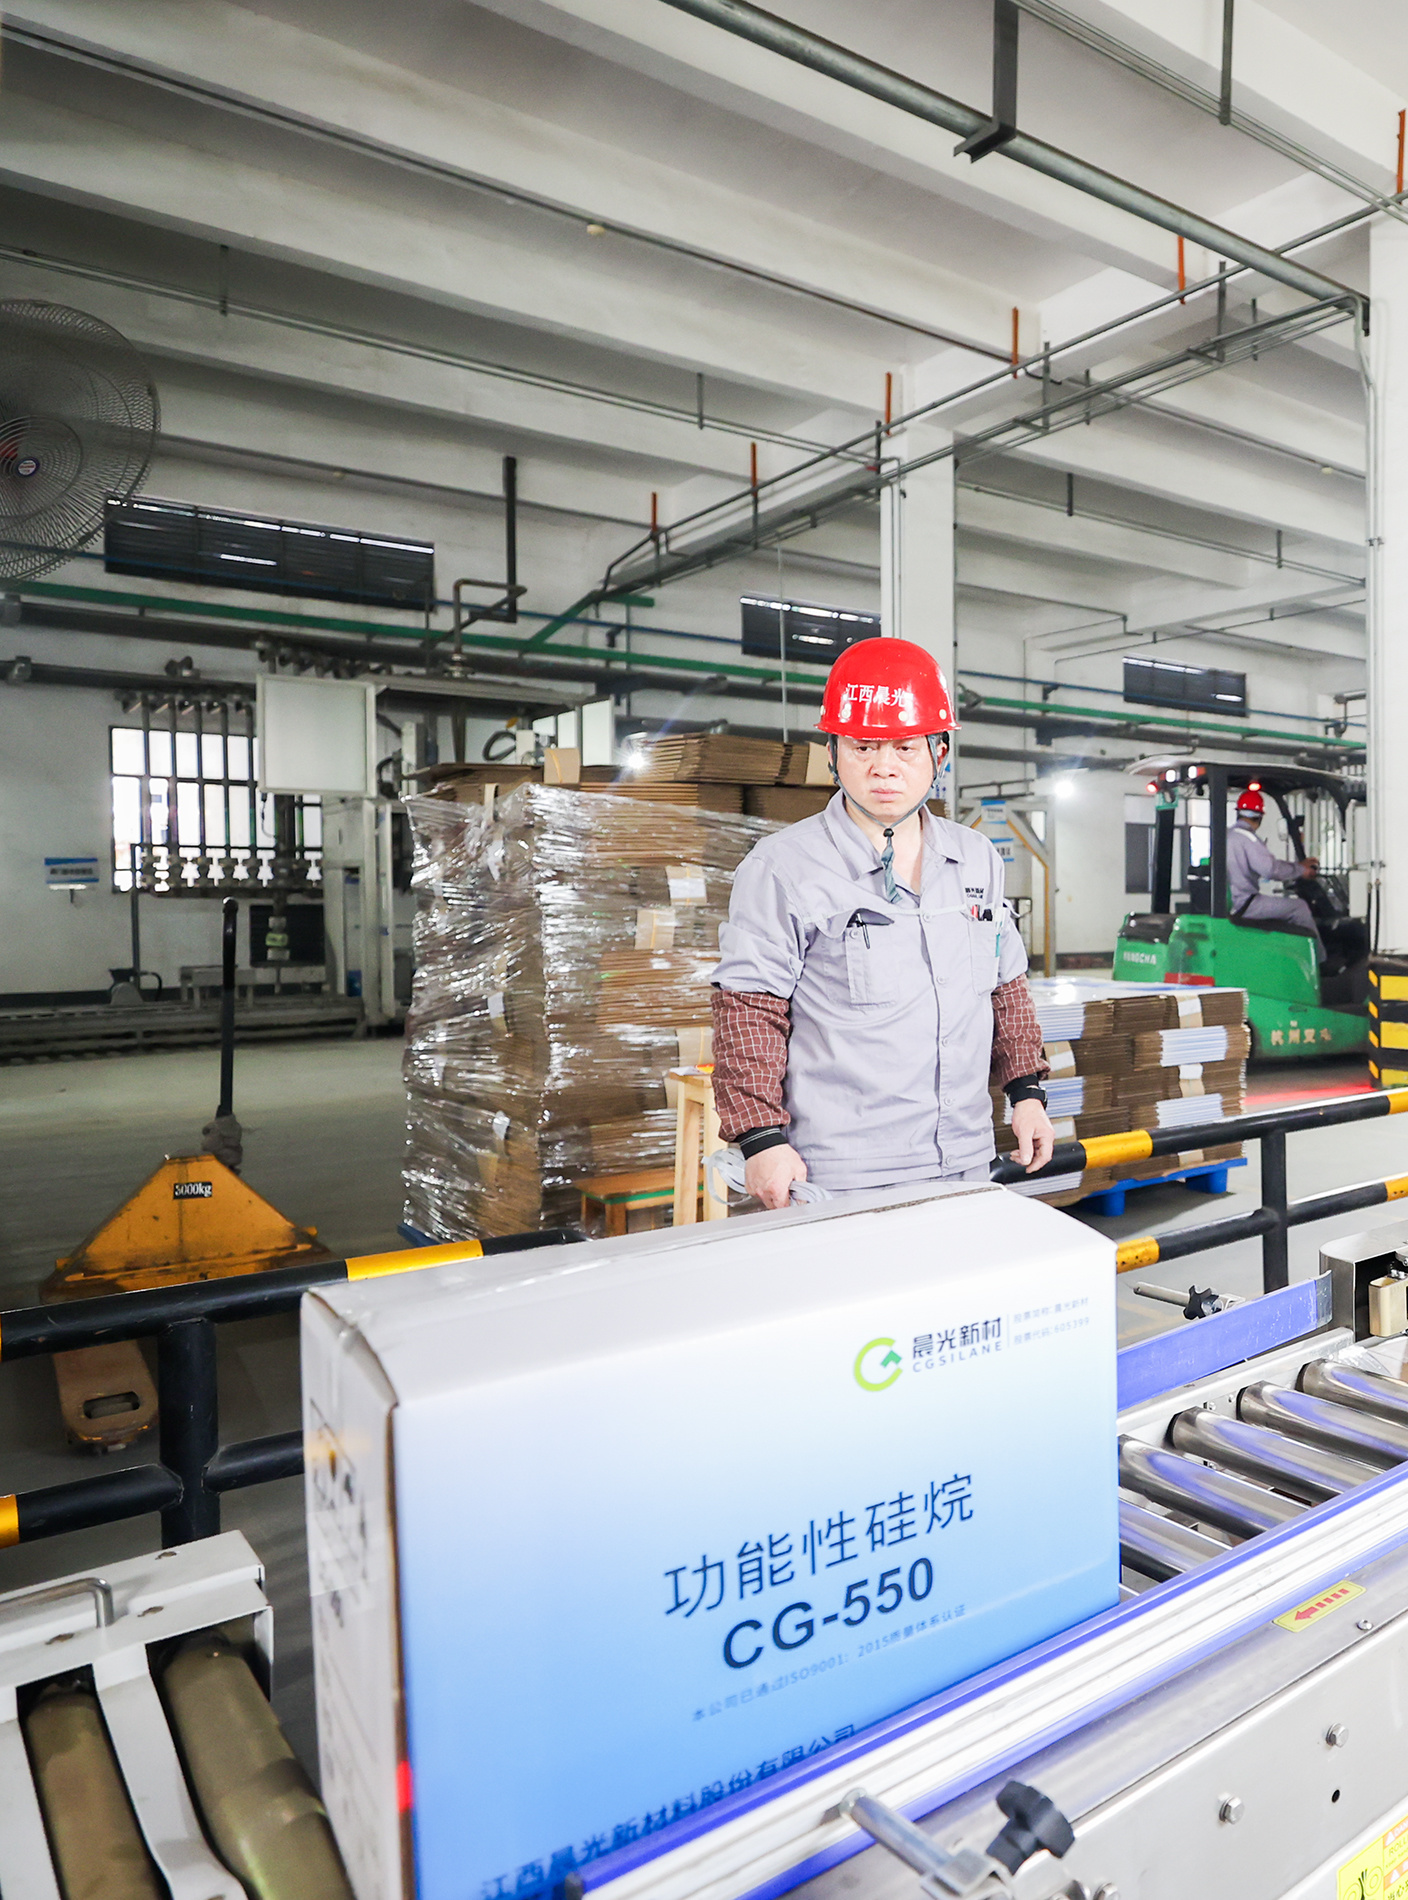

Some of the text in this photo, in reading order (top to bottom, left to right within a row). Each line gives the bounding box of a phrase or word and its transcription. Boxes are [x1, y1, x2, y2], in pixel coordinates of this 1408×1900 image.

[845, 683, 907, 708] 江西晨光
[912, 1317, 1001, 1359] 晨光新材
[912, 1340, 1002, 1373] CGSILANE
[664, 1474, 974, 1618] 功能性硅烷
[723, 1557, 934, 1669] CG-550
